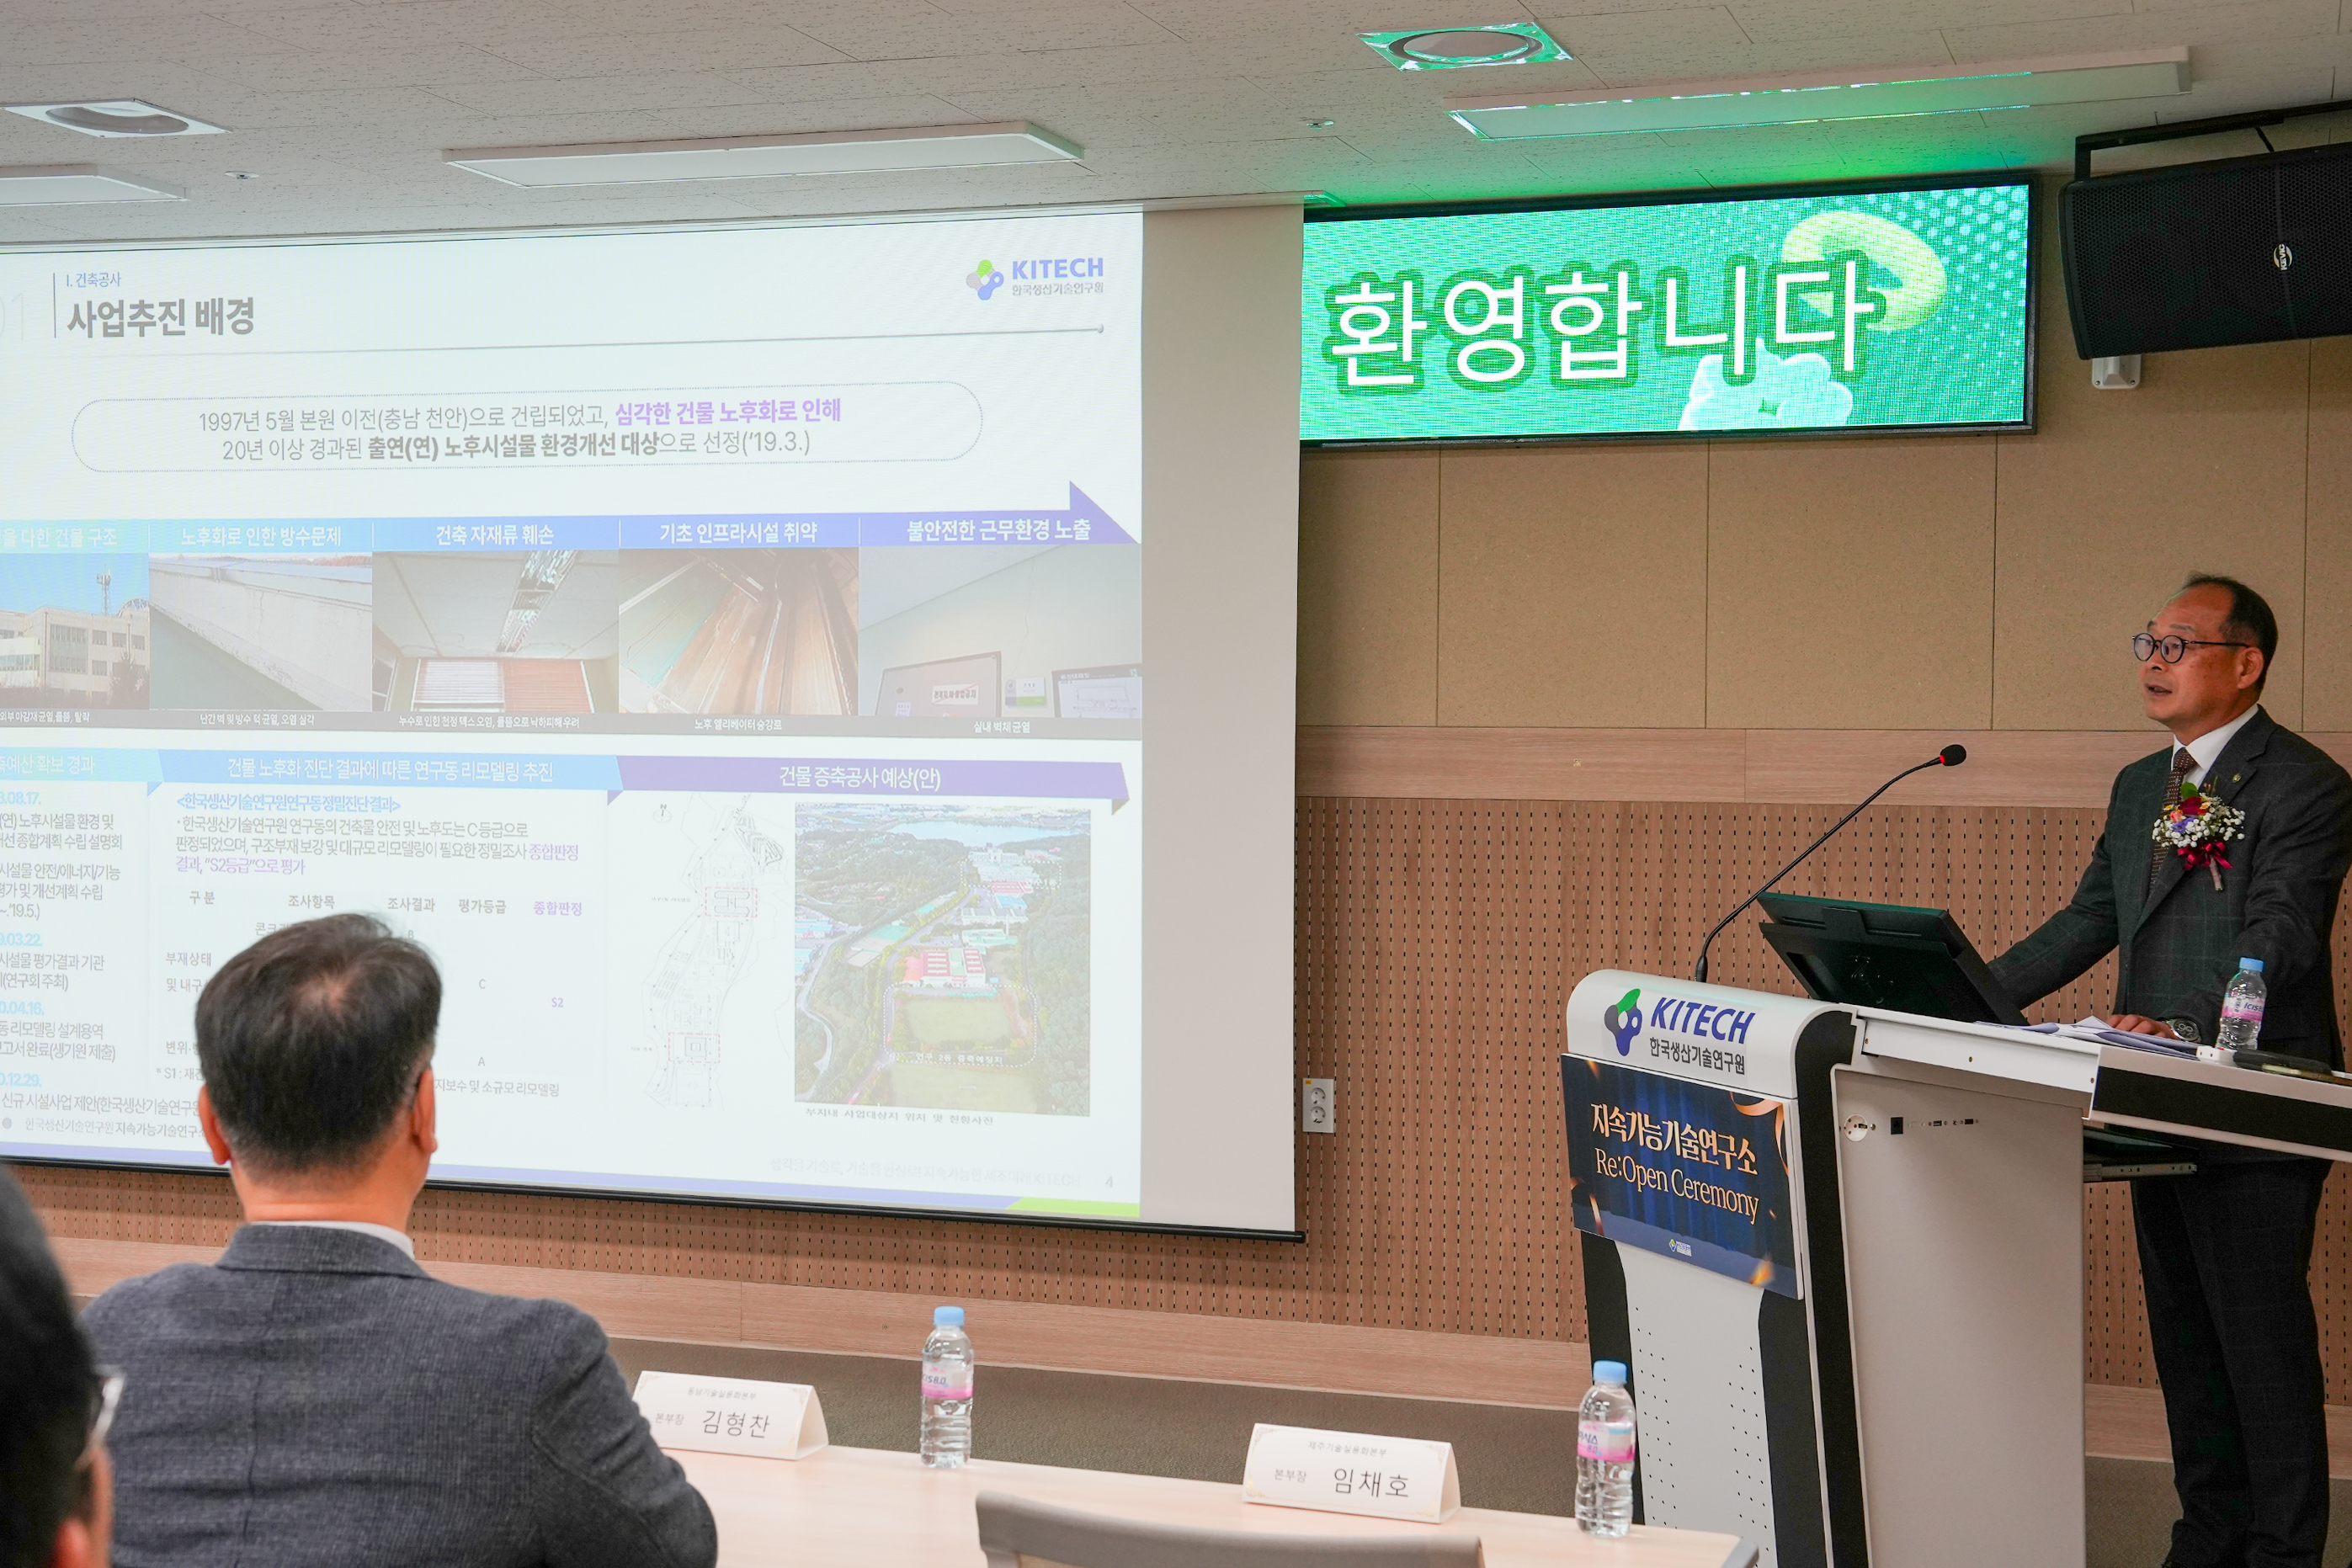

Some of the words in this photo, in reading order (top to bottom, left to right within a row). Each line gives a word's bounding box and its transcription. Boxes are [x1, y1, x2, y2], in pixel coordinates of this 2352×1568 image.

[1013, 258, 1104, 279] KITECH
[76, 272, 122, 288] 건축공사
[1012, 282, 1104, 296] 한국생산기술연구원
[67, 298, 186, 338] 사업추진
[195, 297, 254, 336] 배경
[1331, 259, 1876, 387] 환영합니다
[199, 409, 259, 432] 1997년
[265, 408, 295, 432] 5월
[300, 407, 335, 431] 본원
[342, 407, 420, 433] 이전(충남
[426, 406, 504, 432] 천안)으로
[511, 402, 608, 429] 건립되었고,
[615, 402, 671, 427] 심각한
[677, 401, 715, 425] 건물
[720, 400, 798, 423] 노후화로
[802, 398, 842, 422] 인해
[223, 439, 263, 461] 20년
[269, 439, 305, 460] 이상
[310, 437, 363, 460] 경과된
[368, 435, 439, 462] 출연(연)
[445, 433, 536, 459] 노후시설물
[541, 431, 616, 457] 환경개선
[621, 432, 697, 455] 대상으로
[21, 528, 51, 547] 다한
[55, 529, 83, 547] 건물
[88, 529, 118, 547] 구조
[181, 527, 242, 546] 노후화로
[246, 526, 276, 546] 인한
[279, 526, 342, 547] 방수문제
[436, 525, 467, 545] 건축
[470, 525, 519, 545] 자재류
[521, 525, 555, 545] 훼손
[660, 524, 694, 545] 기초
[697, 521, 779, 544] 인프라시설
[783, 521, 818, 544] 취약
[907, 520, 976, 542] 불안전한
[979, 519, 1051, 541] 근무환경
[1054, 518, 1091, 540] 노출
[694, 719, 712, 730] 노후
[973, 720, 992, 733] 실내
[993, 721, 1012, 733] 벽체
[1012, 721, 1031, 734] 균열
[36, 755, 65, 774] 확보
[67, 756, 95, 774] 경과
[227, 758, 256, 778] 건물
[258, 758, 301, 779] 노후화
[304, 759, 333, 779] 진단
[336, 759, 378, 779] 결과에
[382, 760, 412, 779] 따른
[414, 761, 459, 781] 연구동
[462, 761, 519, 782] 리모델링
[523, 762, 553, 783] 추진
[780, 766, 811, 787] 건물
[814, 766, 879, 788] 증축공사
[881, 767, 941, 792] 예상(안)
[19, 813, 76, 830] 노후시설물
[77, 813, 100, 830] 환경
[102, 813, 114, 831] 및
[290, 817, 337, 835] 연구동의
[338, 818, 375, 836] 건축물
[377, 820, 401, 837] 안전
[403, 820, 415, 837] 및
[418, 820, 466, 838] 노후도는
[16, 833, 62, 849] 종합계획
[64, 834, 87, 850] 수립
[88, 834, 123, 850] 설명회
[175, 835, 249, 855] 판정되었으며,
[251, 837, 299, 855] 구조부재
[301, 838, 326, 856] 보강
[327, 839, 338, 857] 및
[339, 839, 376, 857] 대규모
[377, 840, 437, 858] 리모델링이
[439, 842, 476, 859] 필요한
[478, 843, 527, 860] 정밀조사
[529, 843, 579, 862] 종합판정
[175, 856, 203, 874] 결과,
[281, 858, 306, 875] 평가
[19, 883, 30, 899] 및
[33, 884, 78, 900] 개선계획
[80, 885, 104, 901] 수립
[288, 894, 335, 910] 조사항목
[387, 897, 436, 912] 조사결과
[458, 899, 507, 915] 평가등급
[534, 901, 583, 917] 종합판정
[34, 954, 80, 970] 평가결과
[82, 955, 105, 971] 기관
[166, 952, 211, 967] 부재상태
[166, 977, 177, 992] 및
[478, 978, 486, 990] C
[551, 997, 564, 1008] S2
[1651, 997, 1755, 1044] KITECH
[10, 1021, 56, 1039] 리모델링
[58, 1023, 104, 1040] 설계용역
[88, 1044, 116, 1063] 제출)
[477, 1056, 486, 1067] A
[1649, 1037, 1746, 1076] 한국생산기술연구원
[469, 1080, 480, 1093] 및
[482, 1081, 514, 1094] 소규모
[516, 1082, 560, 1098] 리모델링
[1, 1092, 24, 1109] 신규
[25, 1093, 72, 1111] 시설사업
[24, 1117, 114, 1133] 한국생산기술연구원
[1590, 1103, 1758, 1175] 지속가능기술연구소
[1104, 1176, 1114, 1188] 4
[1594, 1148, 1669, 1192] Re:Open
[1671, 1169, 1759, 1225] Ceremony
[655, 1412, 684, 1426] 본부장
[703, 1410, 770, 1438] 김형찬
[1274, 1469, 1307, 1483] 본부장
[1334, 1468, 1409, 1498] 임채호
